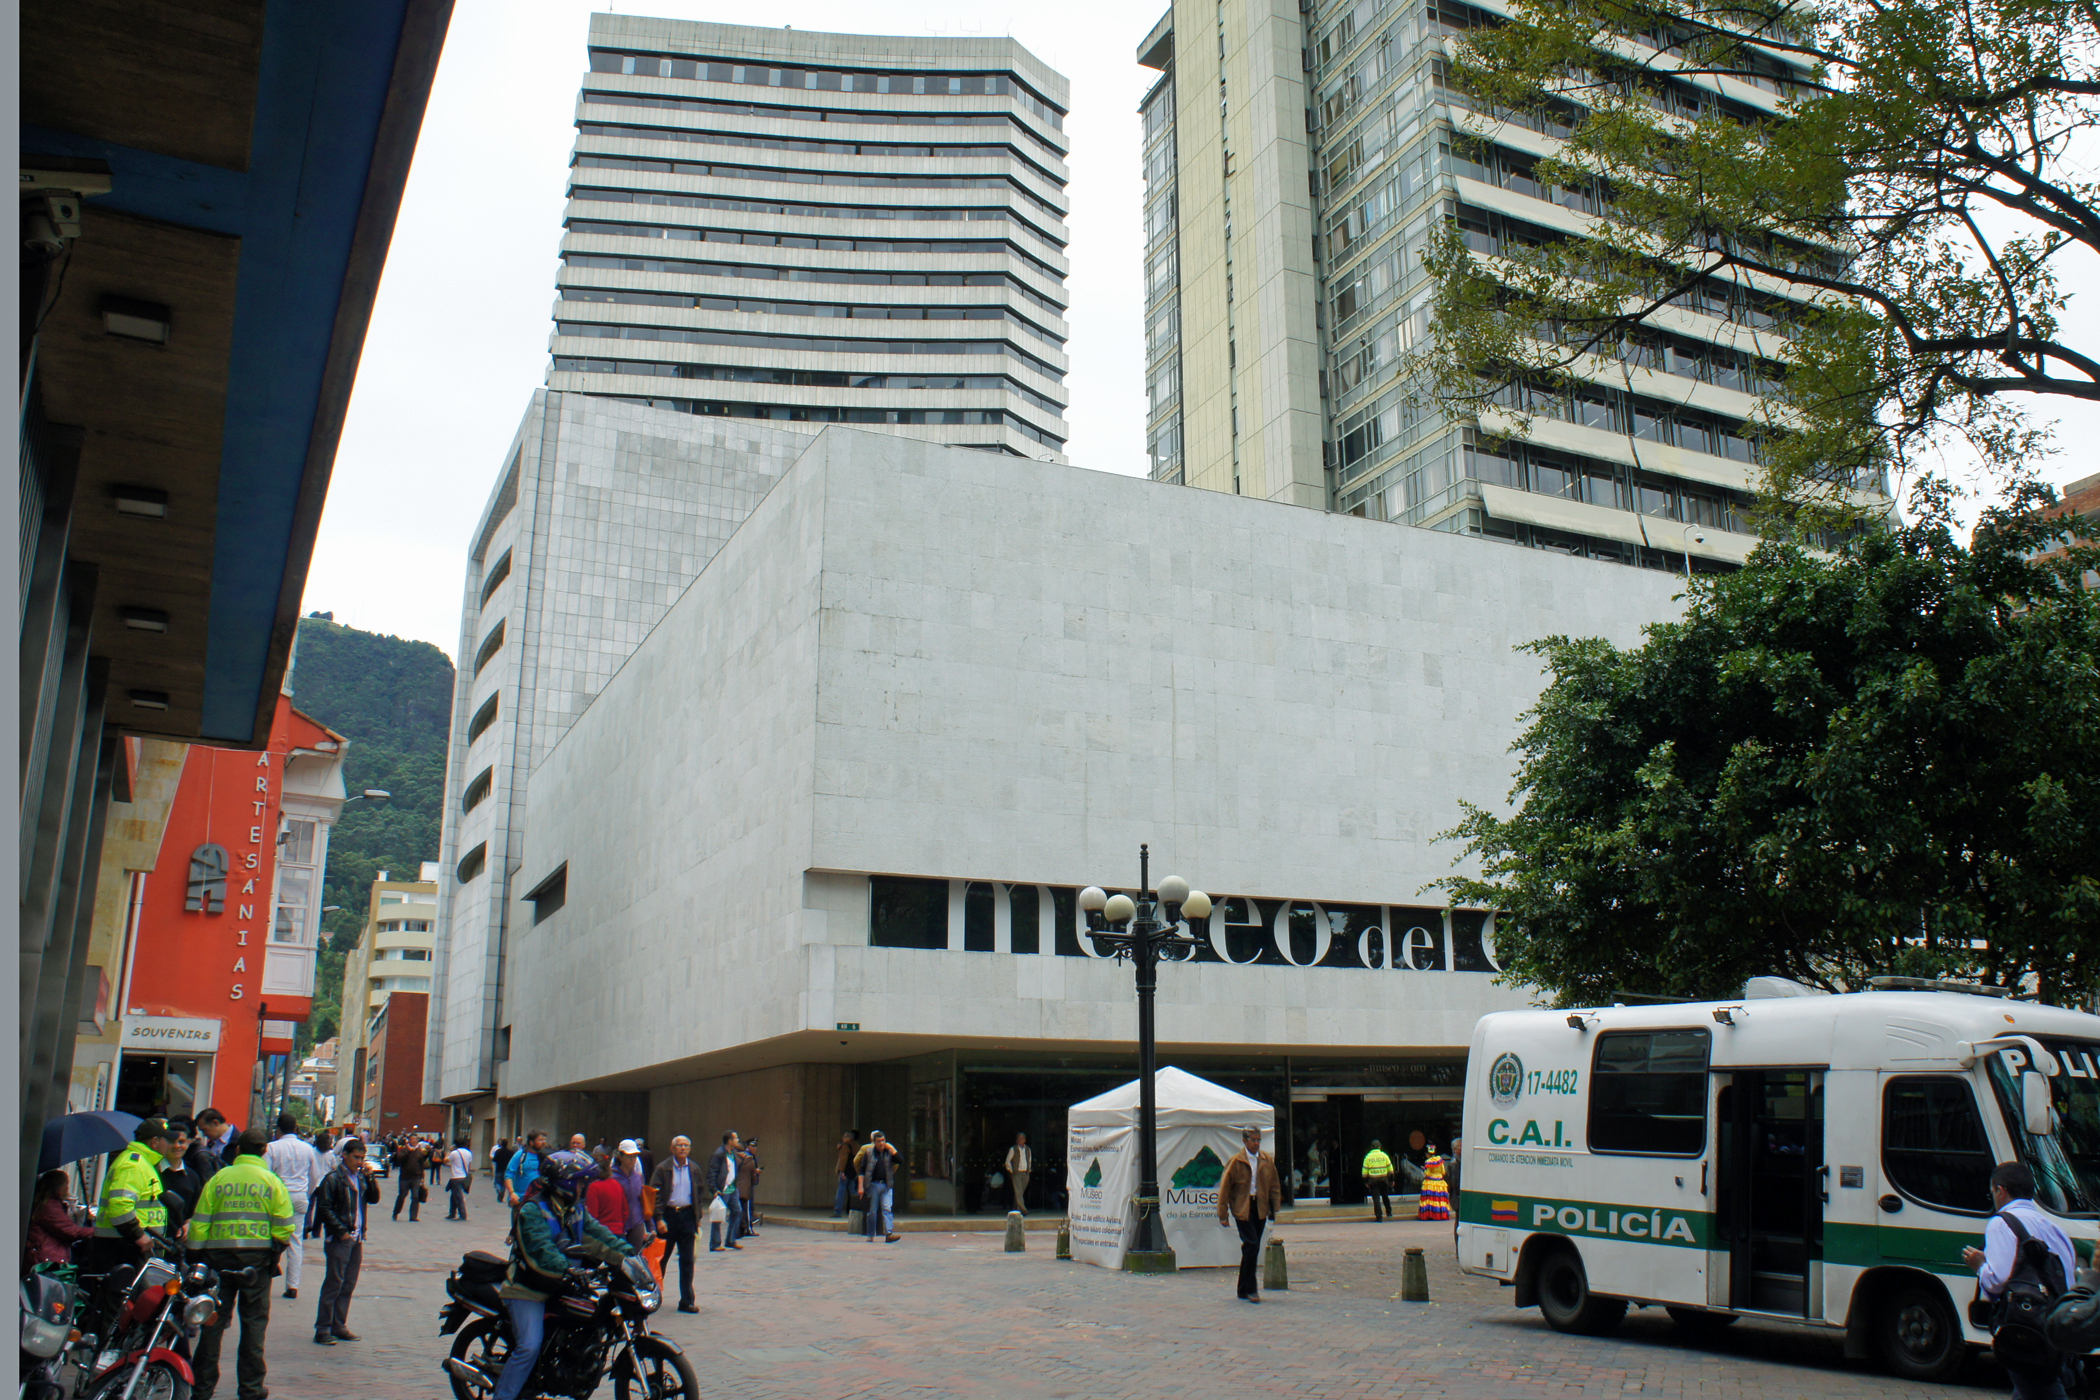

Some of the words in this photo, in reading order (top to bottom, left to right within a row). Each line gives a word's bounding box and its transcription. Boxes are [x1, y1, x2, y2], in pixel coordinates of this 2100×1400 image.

[231, 752, 270, 1000] ARTESANIAS
[1357, 905, 1455, 971] del
[132, 1027, 212, 1040] SOUVENIRS
[1999, 1049, 2100, 1079] PLI
[1527, 1069, 1578, 1095] 17-4482
[1488, 1118, 1572, 1147] C.A.I.
[215, 1183, 273, 1200] POLICIA
[224, 1200, 261, 1208] MEBOG
[1081, 1187, 1103, 1199] Museo
[1166, 1189, 1219, 1204] Muse
[1533, 1204, 1696, 1243] POLICÍA
